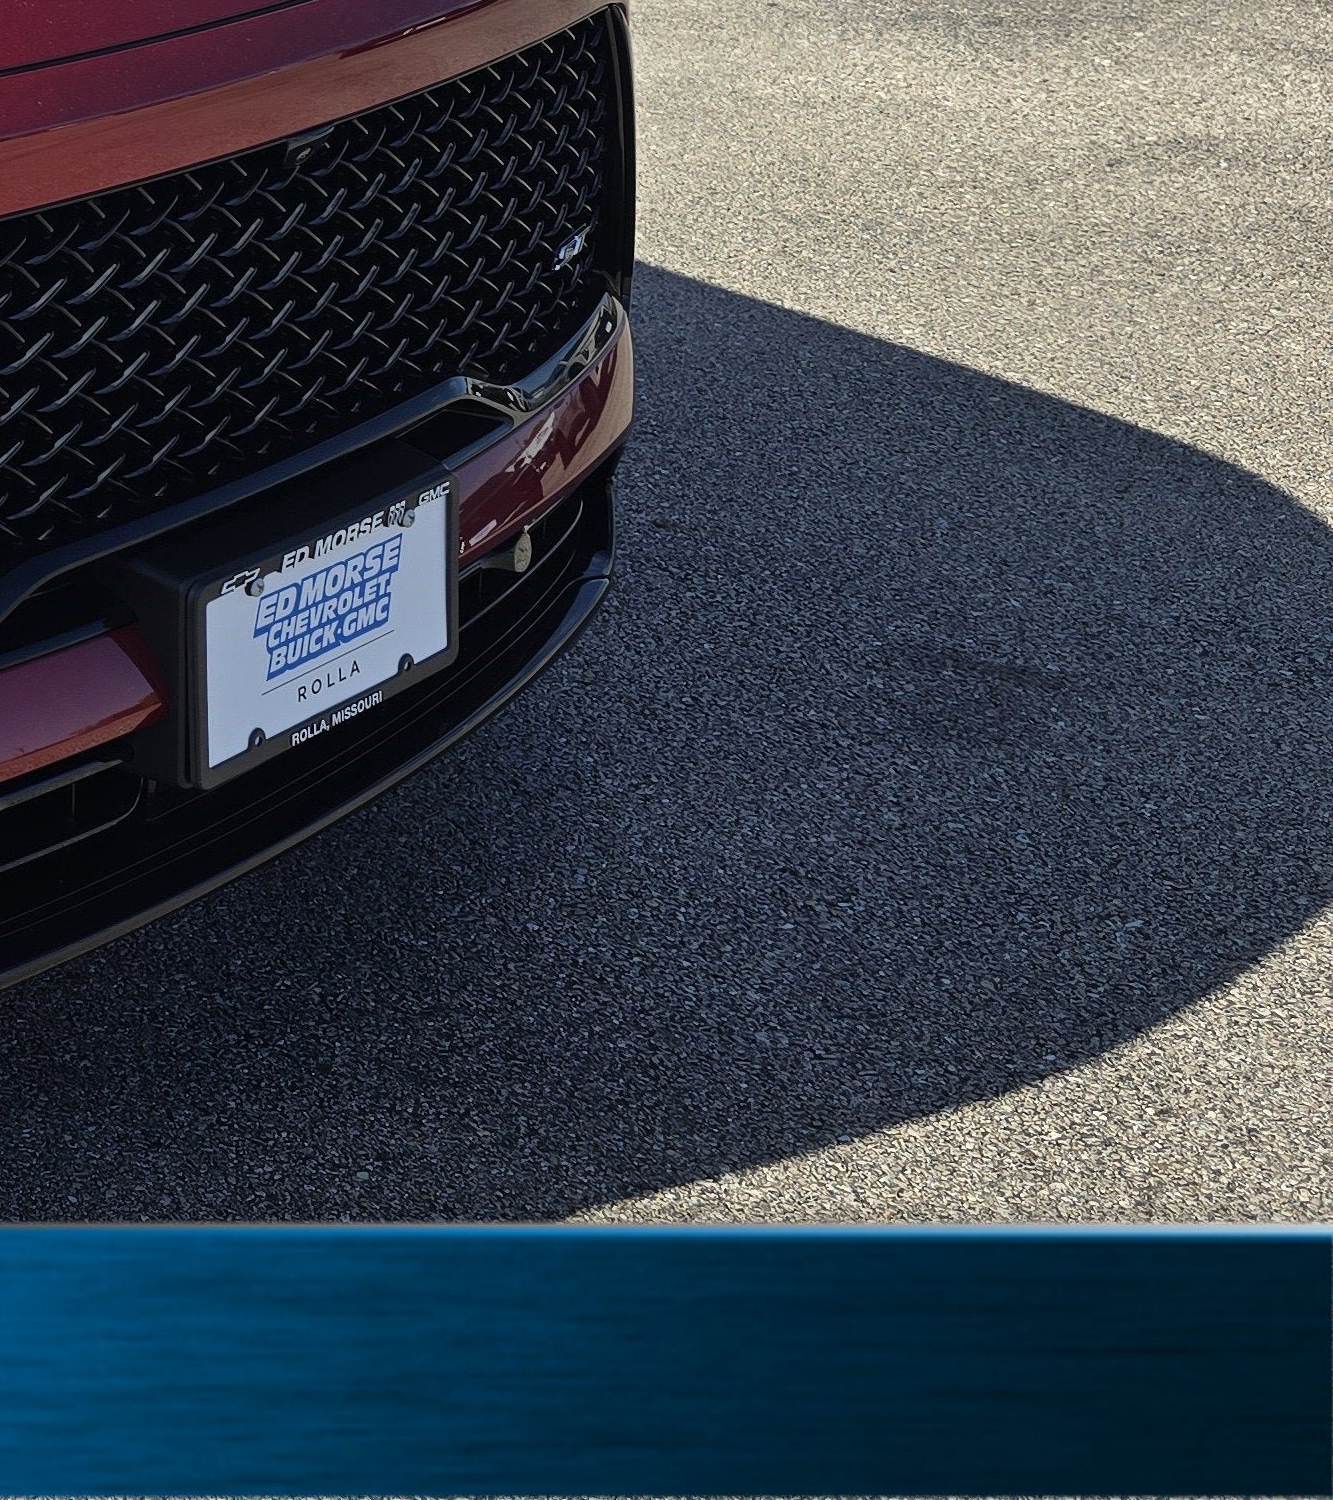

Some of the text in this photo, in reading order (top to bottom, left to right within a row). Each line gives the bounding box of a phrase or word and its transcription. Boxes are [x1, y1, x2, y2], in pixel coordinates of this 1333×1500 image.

[282, 482, 450, 573] ED MORSE GMC
[256, 536, 402, 630] ED MORSE
[268, 571, 391, 649] CHEVROLET
[291, 690, 383, 747] ROLLA, MISSOURI
[297, 660, 360, 702] ROLLA
